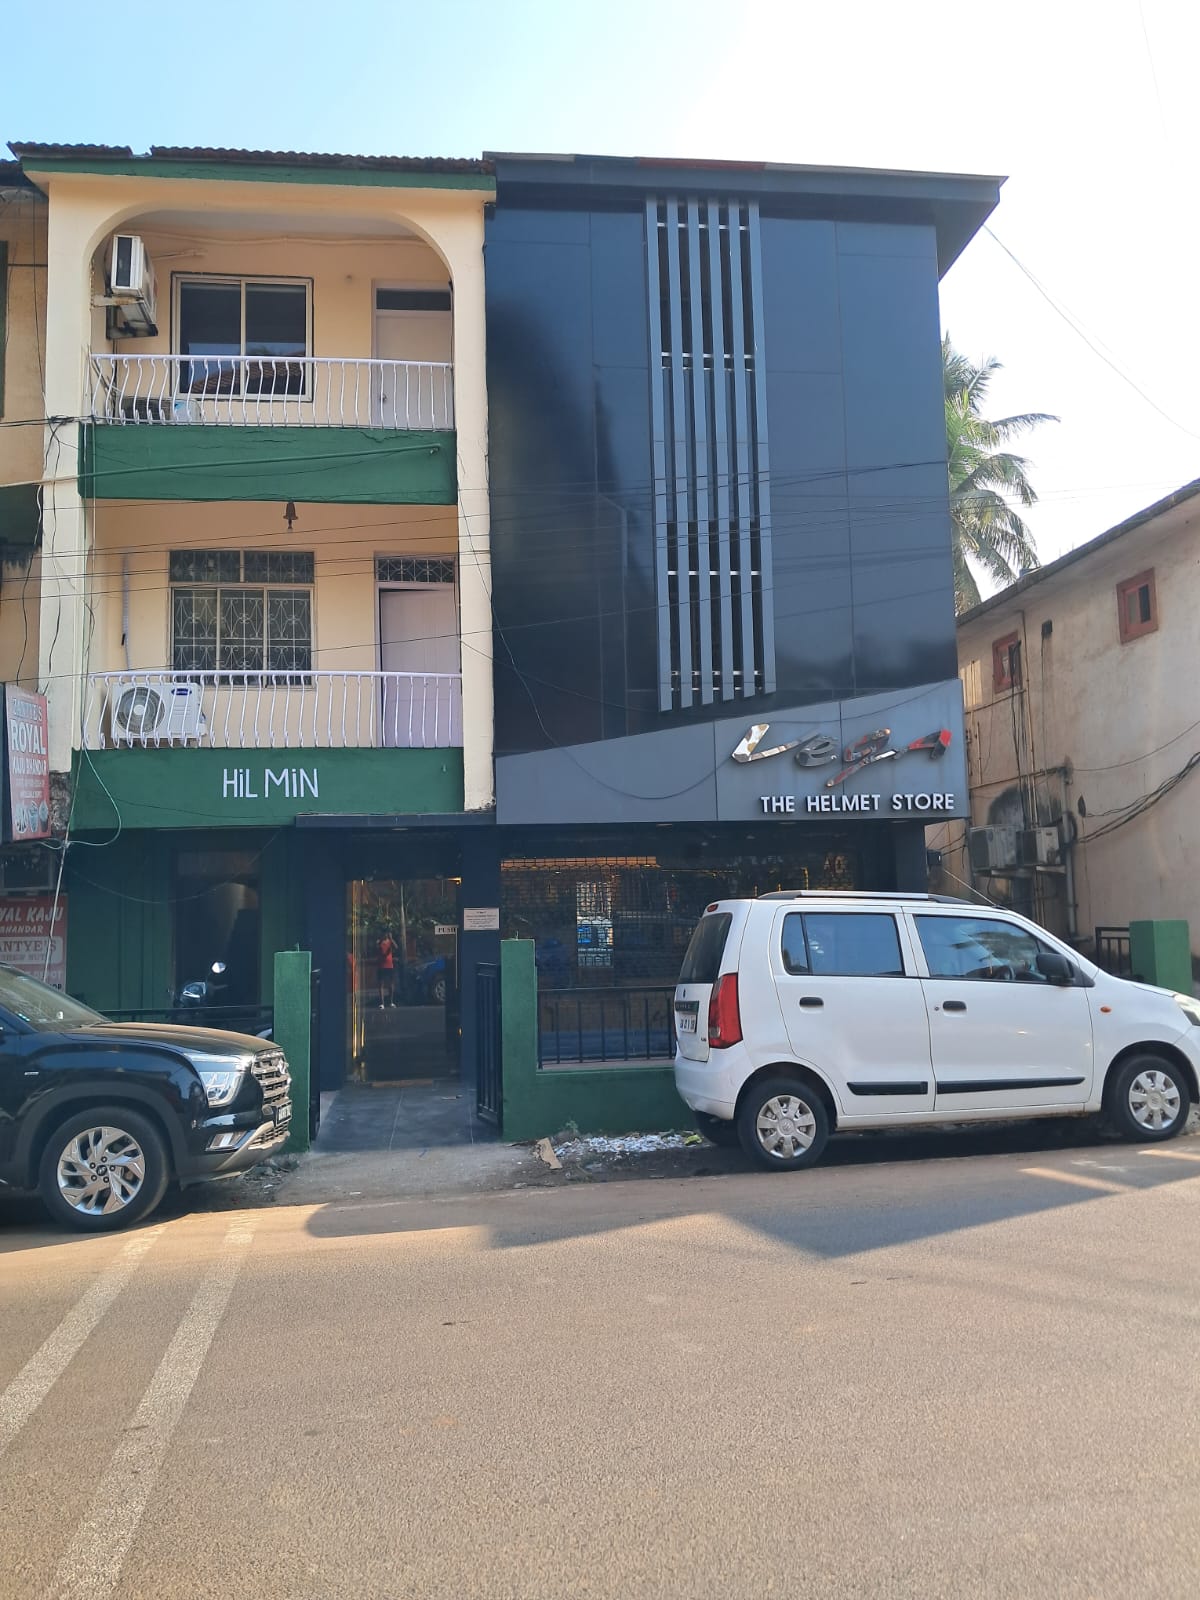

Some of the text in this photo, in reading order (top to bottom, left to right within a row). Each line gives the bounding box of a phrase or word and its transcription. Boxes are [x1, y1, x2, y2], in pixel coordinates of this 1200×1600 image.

[10, 719, 46, 755] ROYAL
[761, 793, 955, 812] THE HELMET STORE
